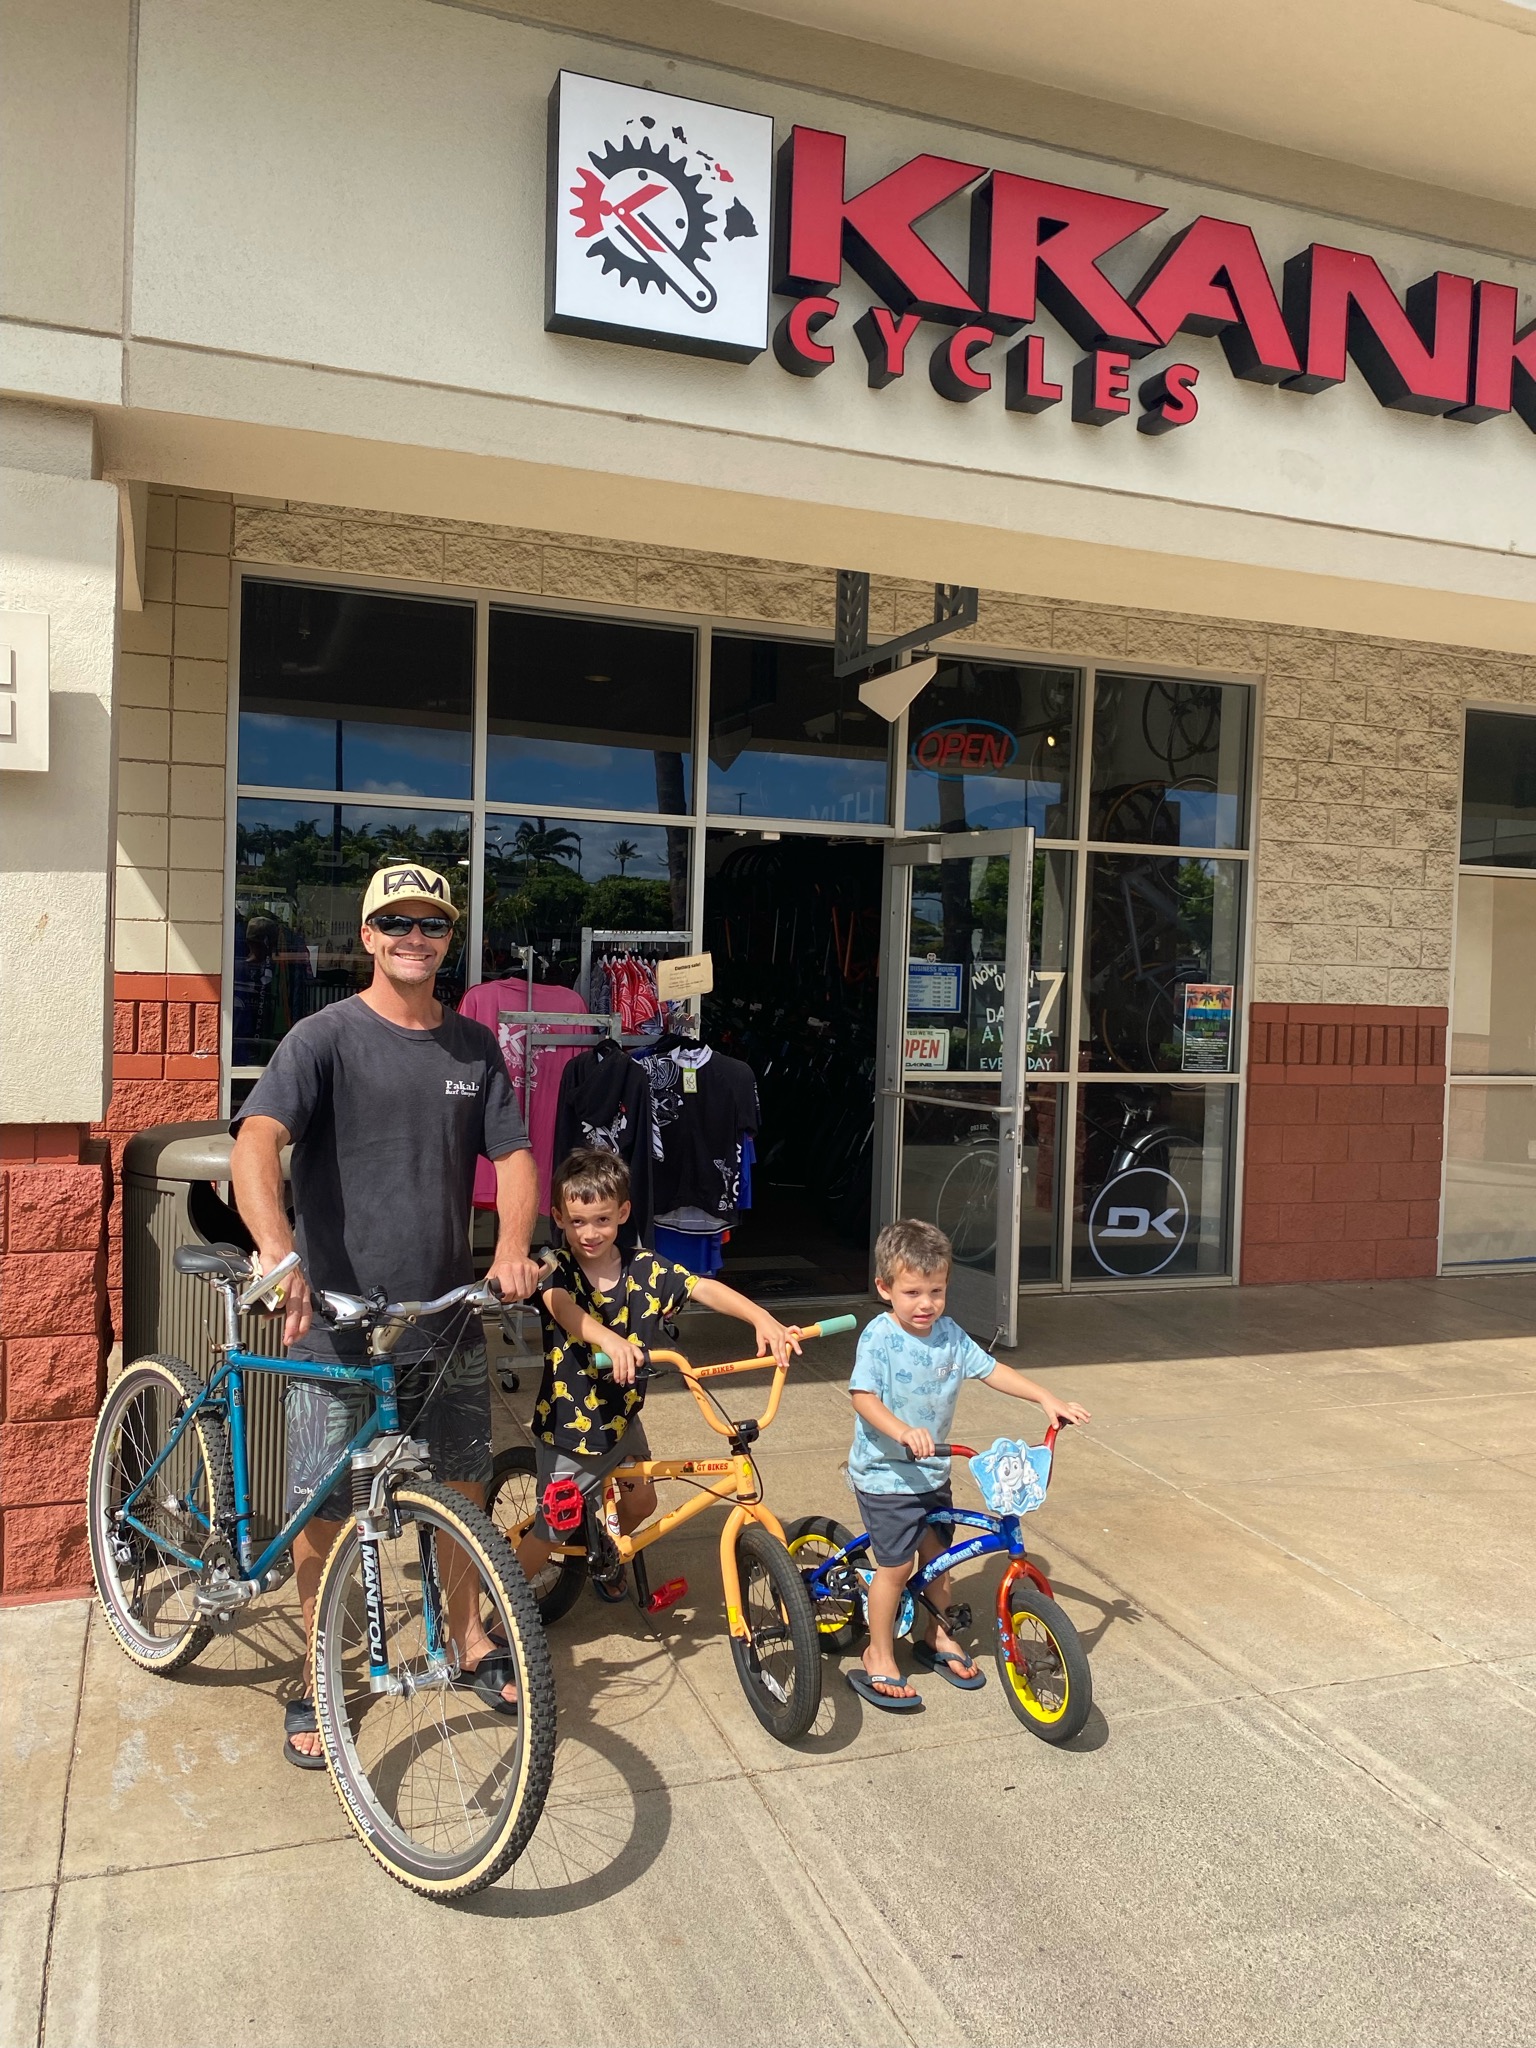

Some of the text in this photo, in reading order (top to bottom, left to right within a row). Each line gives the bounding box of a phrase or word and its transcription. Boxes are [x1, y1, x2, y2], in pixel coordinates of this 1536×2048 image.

[776, 297, 1199, 434] CYCLES
[917, 733, 1011, 769] OPEN
[971, 964, 998, 990] NOW
[1034, 972, 1066, 1029] 7
[982, 1025, 994, 1043] A
[980, 1056, 1053, 1071] EVEDAY
[1098, 1206, 1180, 1238] DK
[700, 1364, 735, 1377] GT BIKES
[707, 1463, 729, 1471] BIKES
[361, 1544, 384, 1662] MANITOU
[338, 1776, 375, 1838] Panaracer
